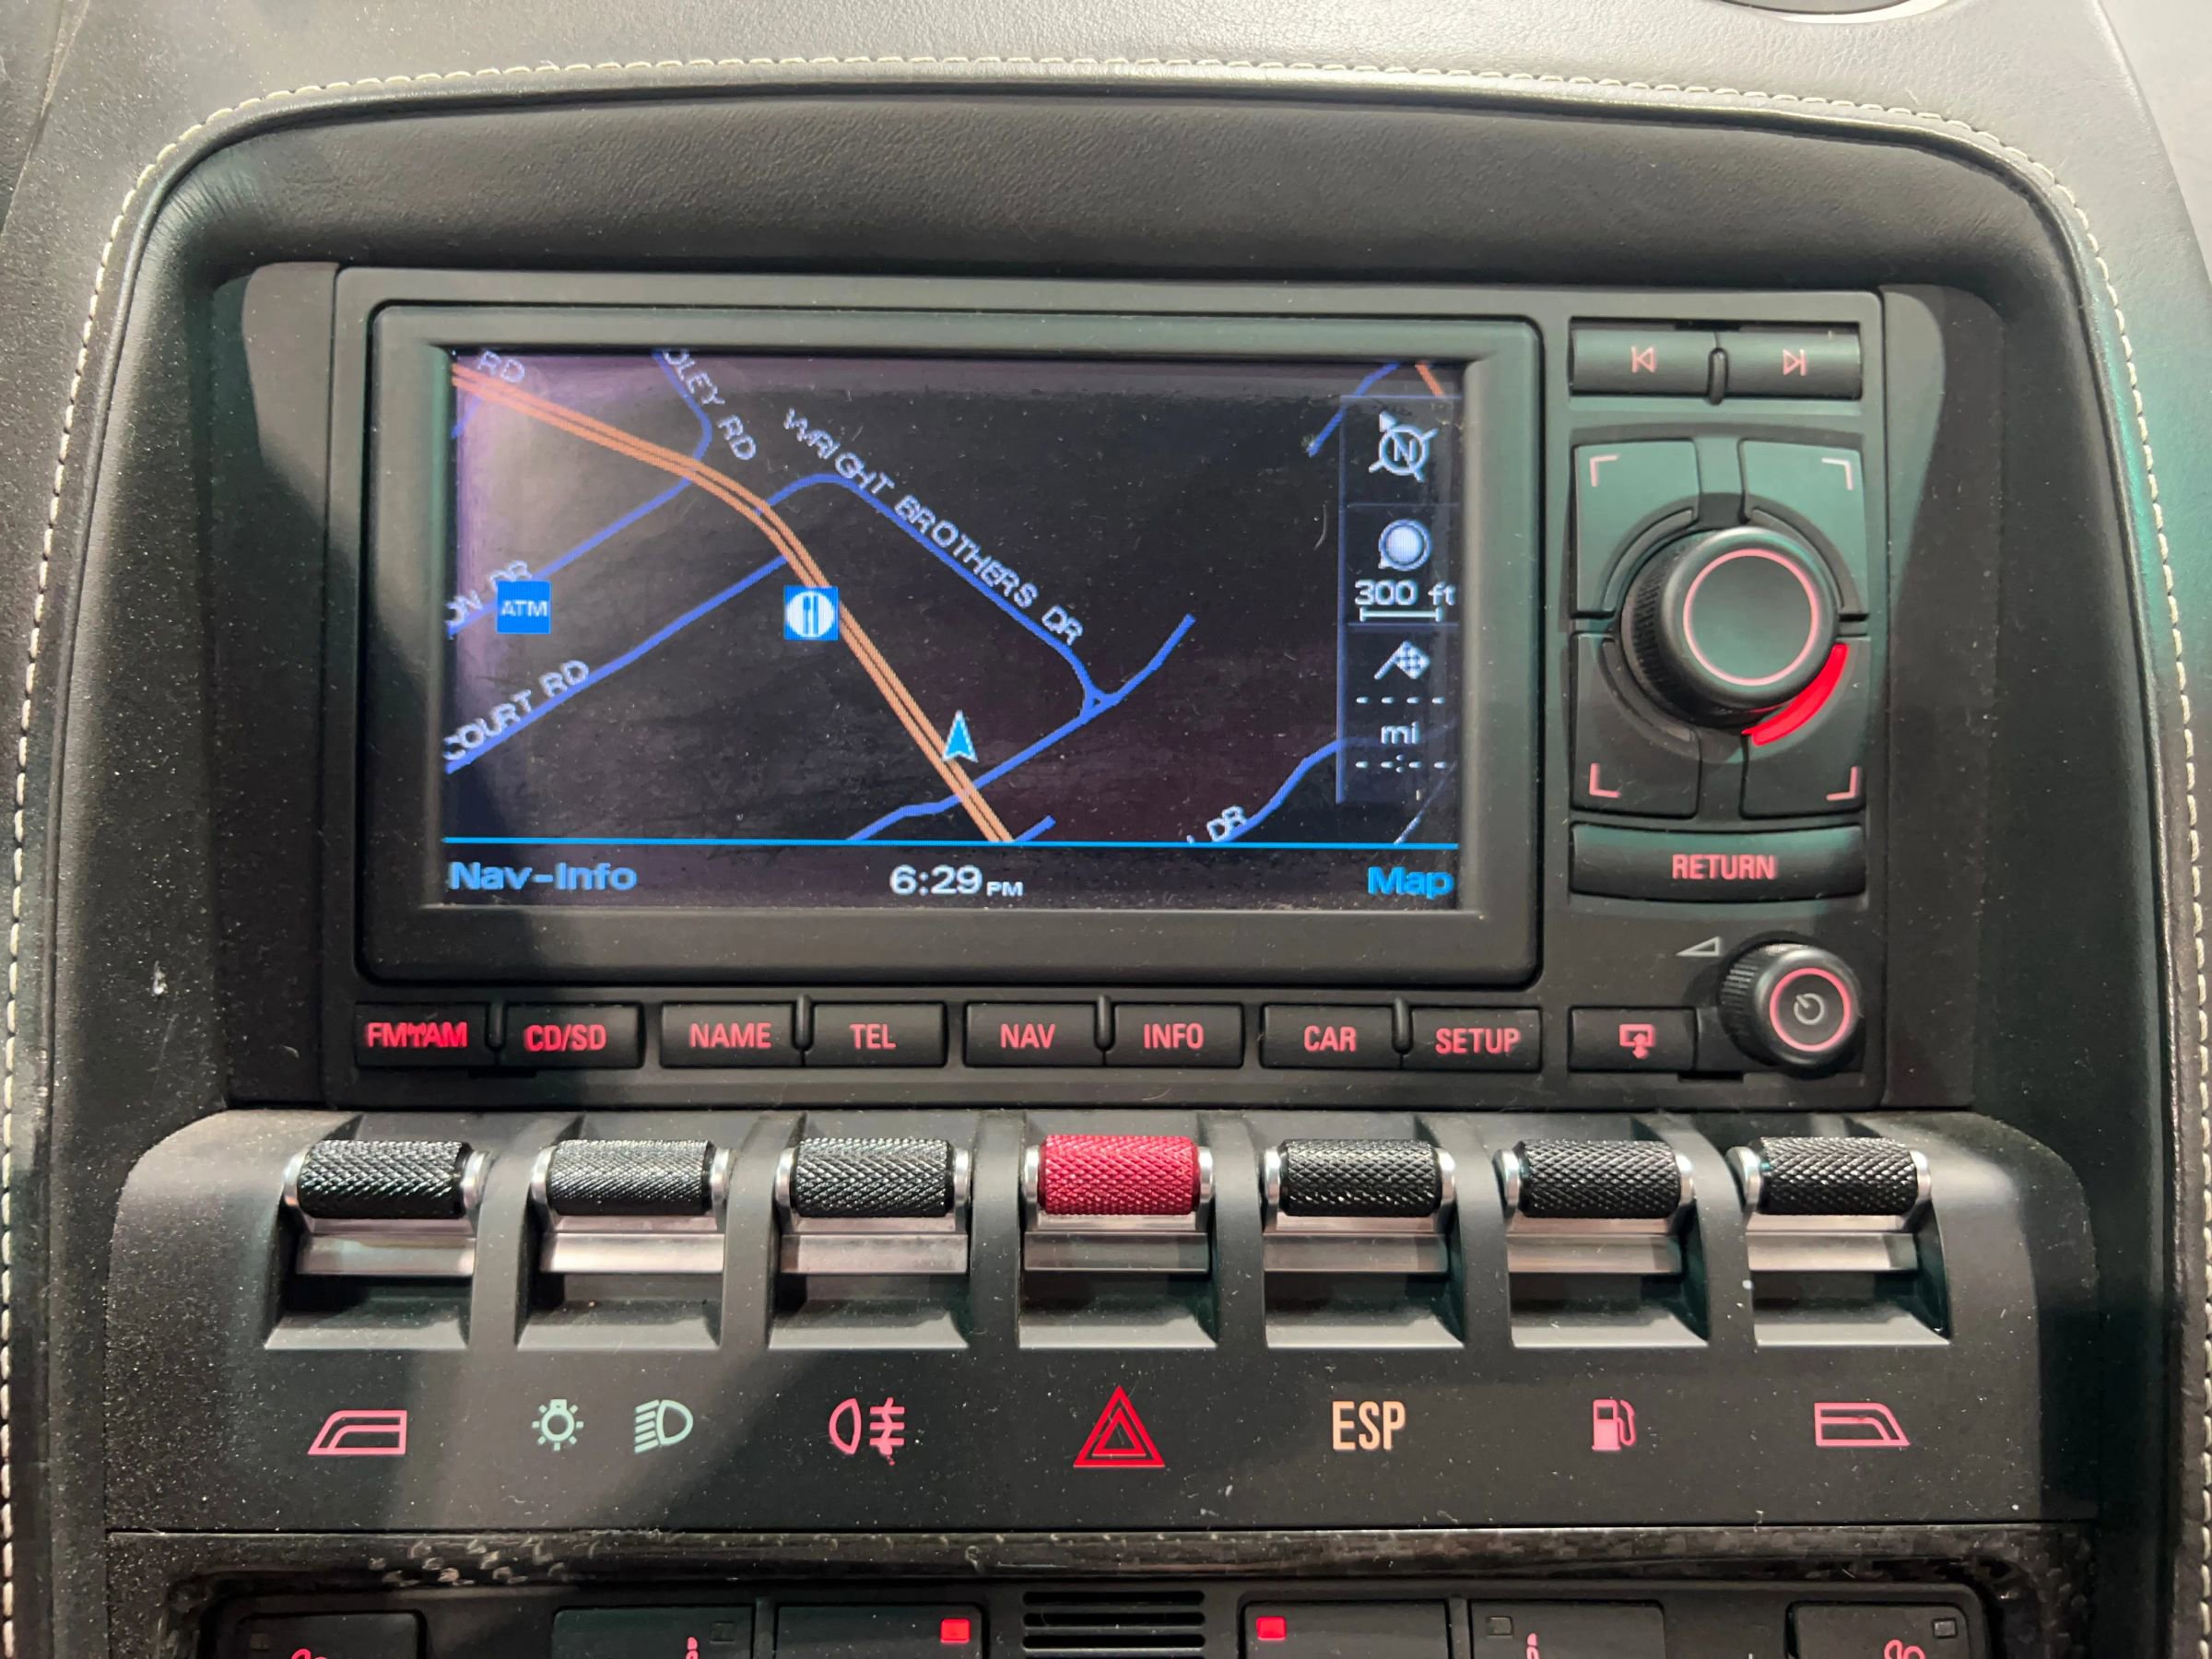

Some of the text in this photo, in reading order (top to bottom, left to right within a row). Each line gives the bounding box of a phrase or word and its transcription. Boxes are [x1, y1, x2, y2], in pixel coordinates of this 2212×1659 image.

[478, 350, 524, 382] RD
[717, 415, 757, 460] RD
[783, 407, 1084, 645] WRIGHT BROTHERS DR
[1354, 581, 1455, 606] 300 ft
[501, 599, 548, 618] ATM
[539, 660, 590, 698] RD
[1382, 723, 1418, 745] mi
[1206, 806, 1247, 842] DR
[448, 862, 638, 892] Nav-Info
[1671, 853, 1777, 880] RETURN
[889, 865, 1024, 898] 6:29 PM
[1367, 865, 1454, 899] Map
[524, 1024, 607, 1052] CD/SD
[688, 1023, 772, 1049] NAME
[850, 1023, 896, 1050] TEL
[999, 1023, 1056, 1049] NAV
[1143, 1023, 1204, 1050] INFO
[1303, 1025, 1358, 1053] CAR
[1434, 1027, 1522, 1054] SETUP
[1332, 1400, 1406, 1452] ESP
